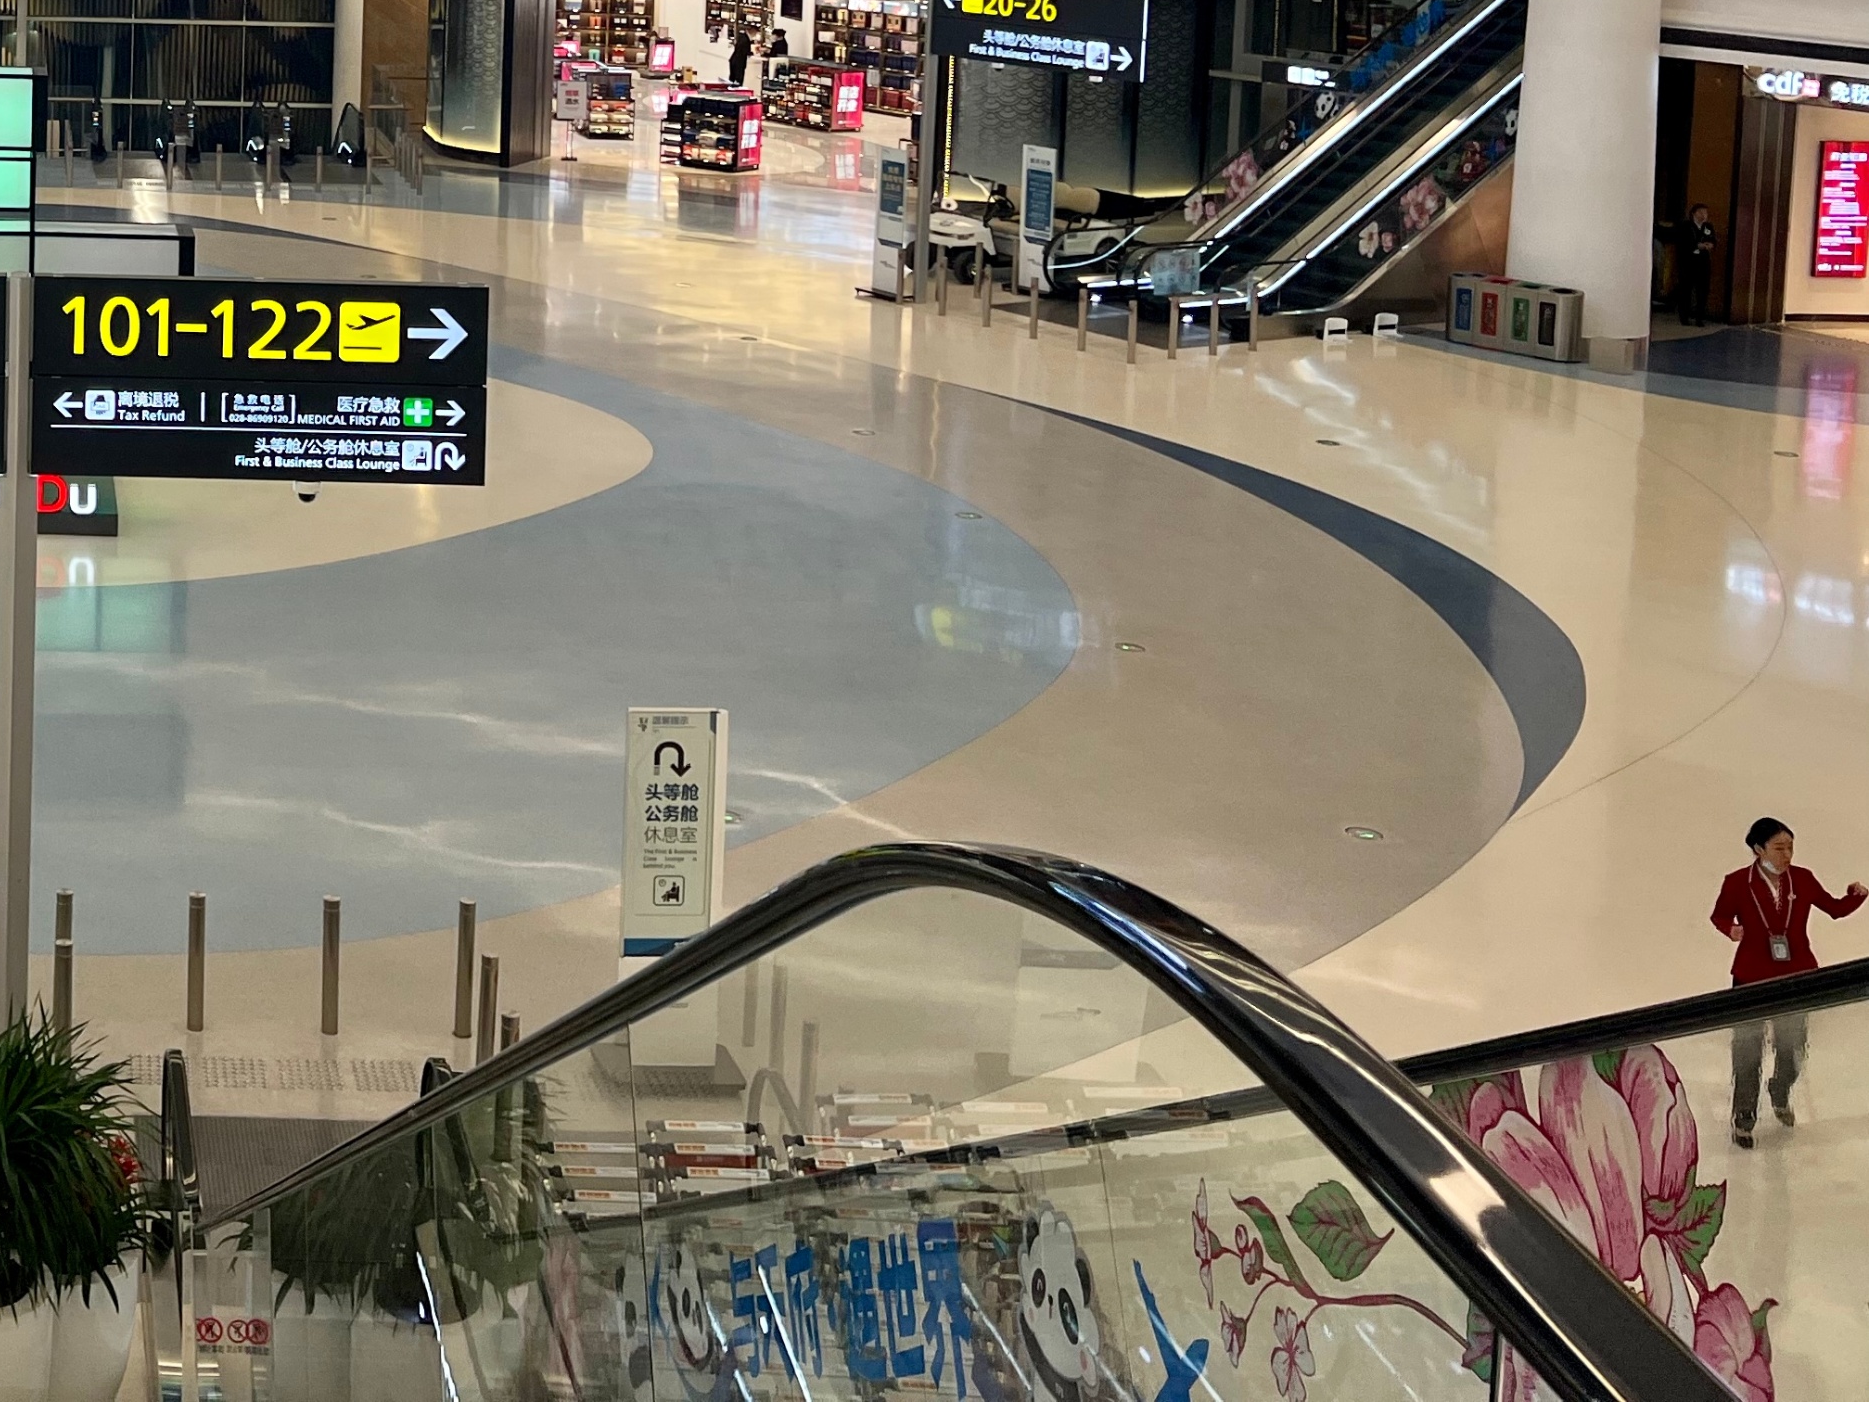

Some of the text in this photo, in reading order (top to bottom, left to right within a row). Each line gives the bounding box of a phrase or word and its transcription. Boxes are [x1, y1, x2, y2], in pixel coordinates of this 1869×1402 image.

[1052, 54, 1084, 70] Lounge
[1756, 70, 1805, 96] cdf
[1830, 81, 1869, 106] 免税
[61, 295, 333, 361] 101-122
[117, 391, 180, 408] 离境退税
[337, 396, 401, 414] 医疗急救
[117, 409, 186, 422] Tax Refund
[297, 414, 401, 427] MEDICAL FIRST AID
[254, 437, 401, 457] 头等舱/公务舱休息室
[235, 454, 400, 473] First & Business Class Lounge
[644, 783, 699, 802] 头等舱
[644, 805, 699, 823] 公务舱
[643, 826, 698, 844] 休息室
